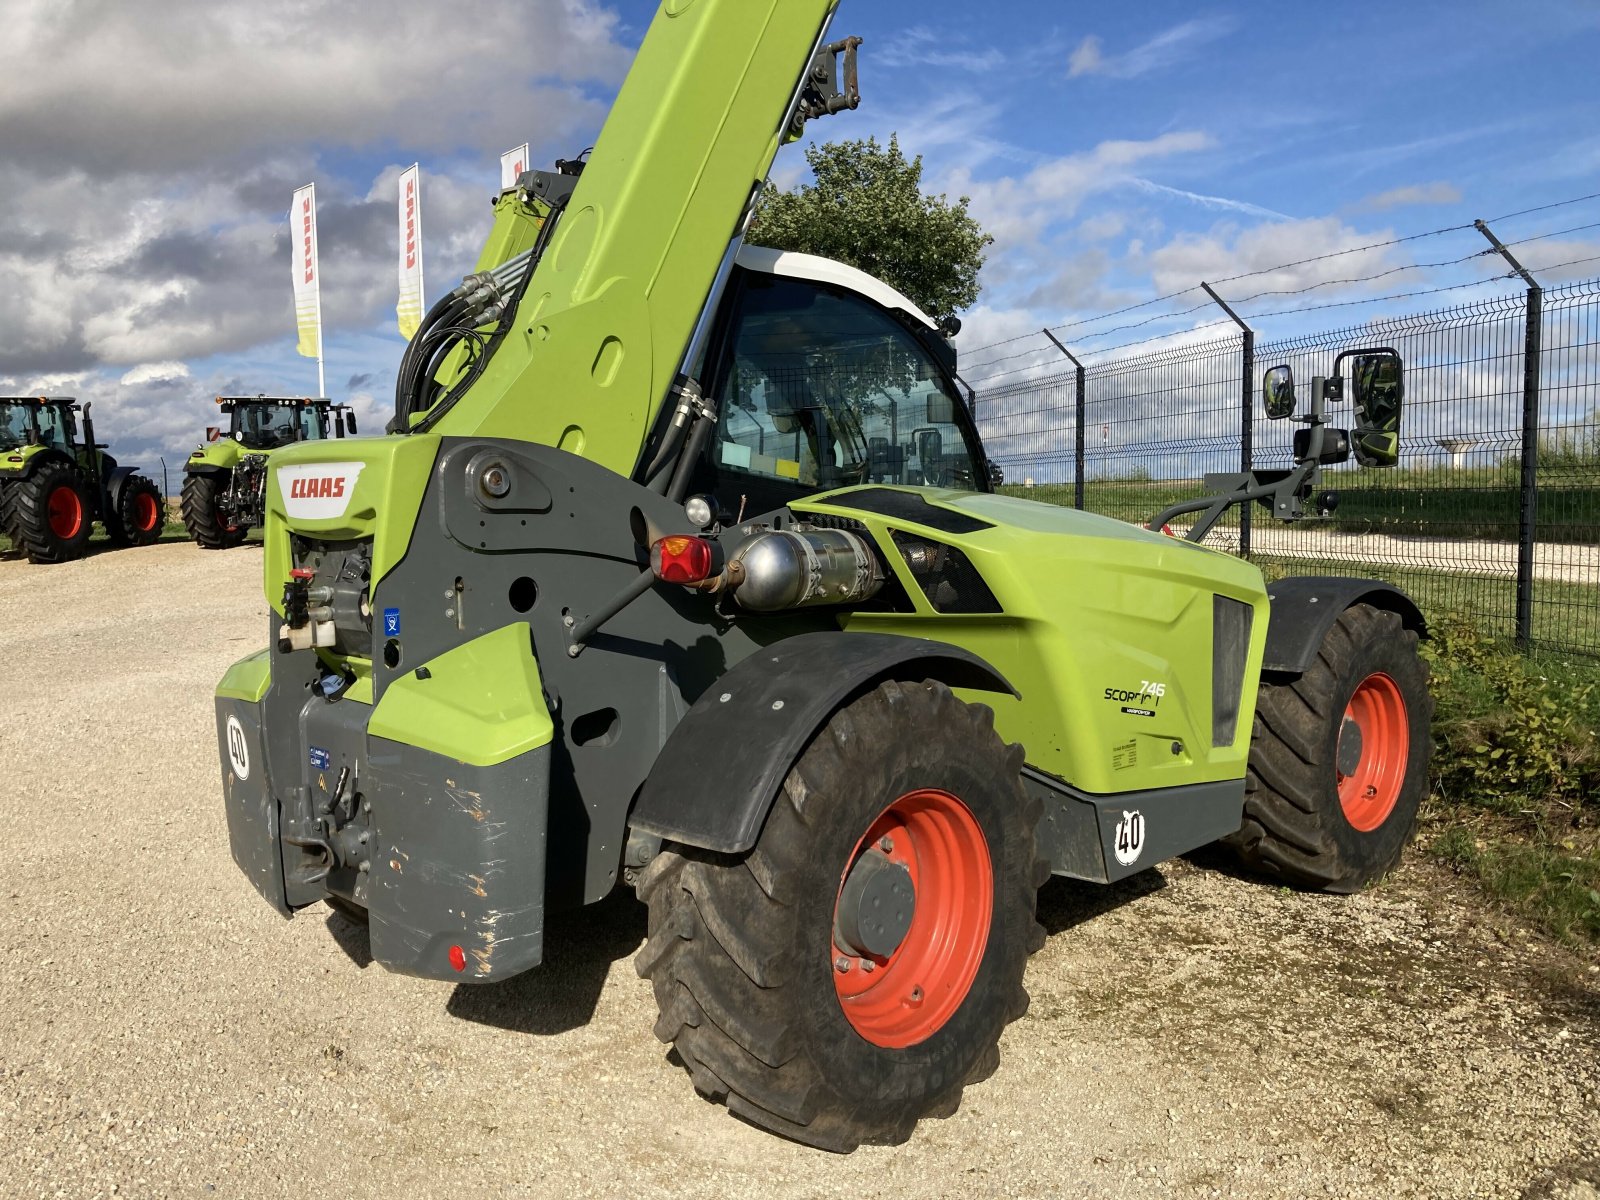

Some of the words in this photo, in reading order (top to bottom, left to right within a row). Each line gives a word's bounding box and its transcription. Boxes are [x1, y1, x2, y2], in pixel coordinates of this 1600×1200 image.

[291, 477, 346, 498] CLAAS
[1139, 680, 1166, 696] 746
[230, 725, 246, 768] 40
[1118, 813, 1140, 854] 40
